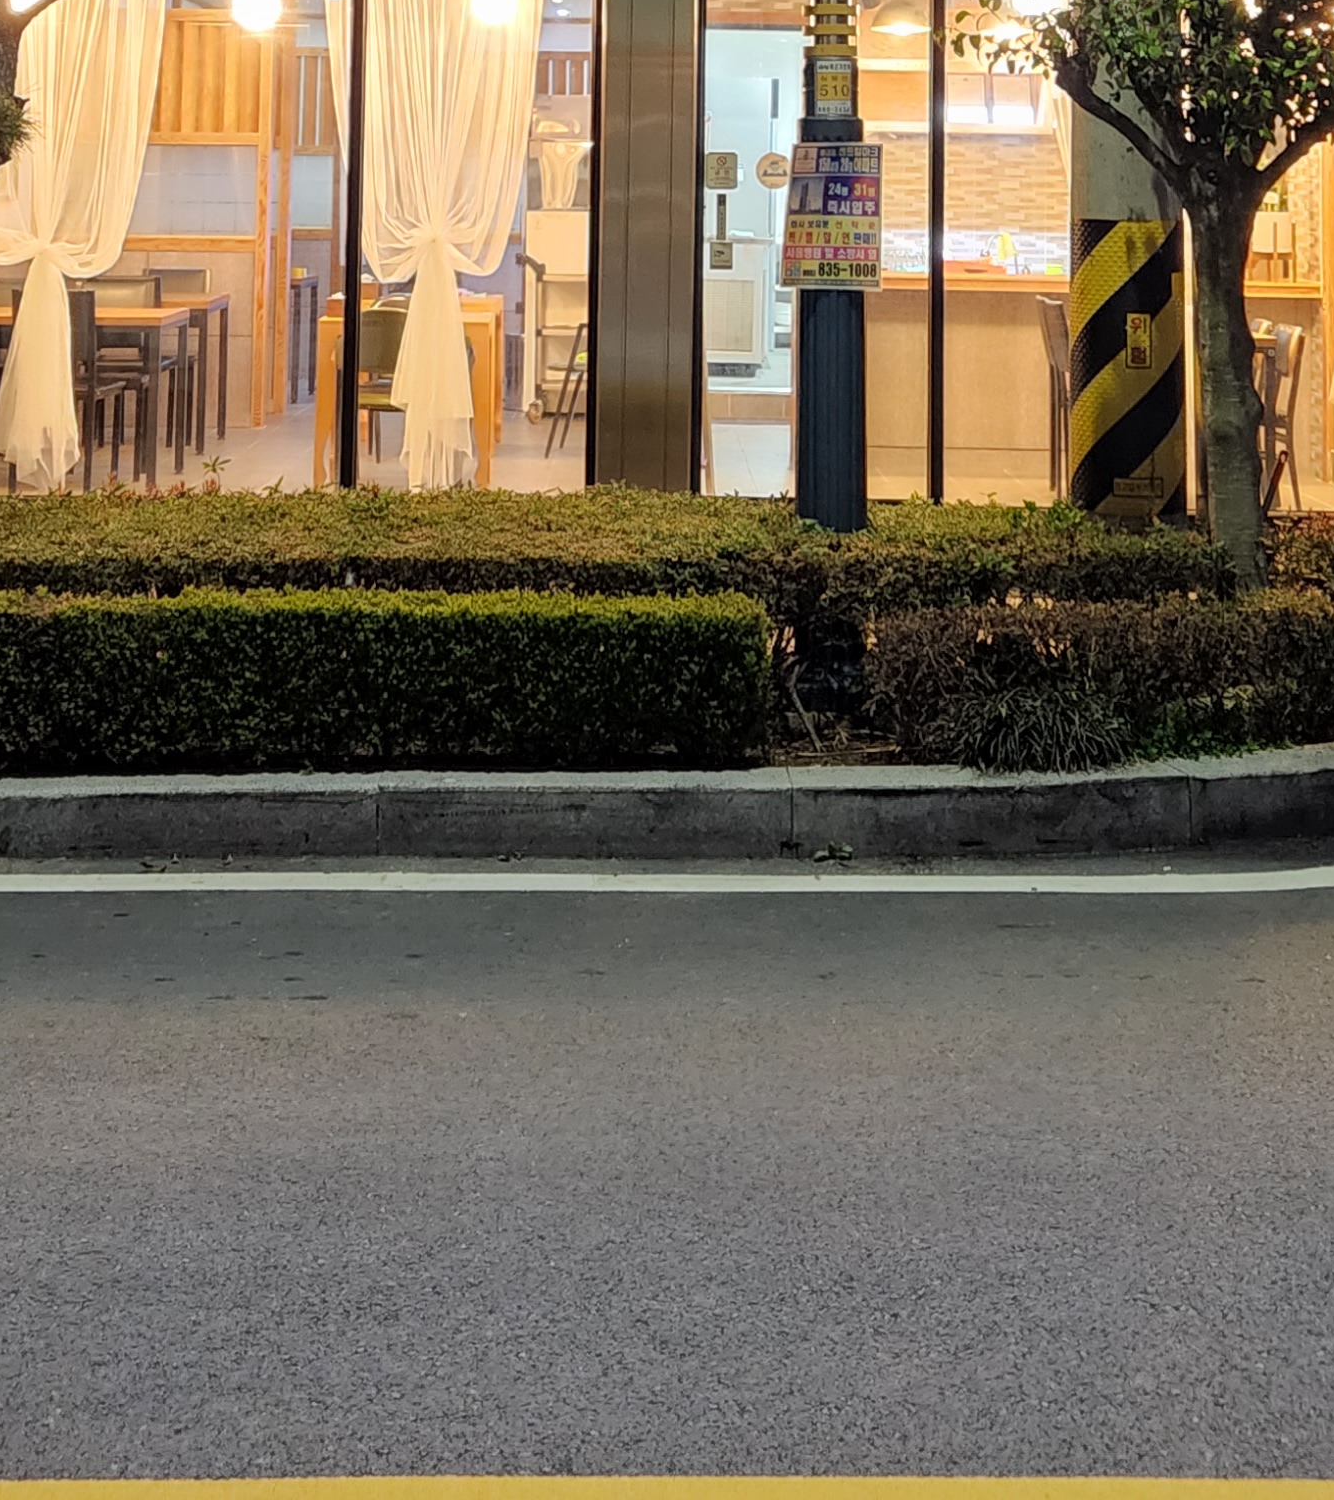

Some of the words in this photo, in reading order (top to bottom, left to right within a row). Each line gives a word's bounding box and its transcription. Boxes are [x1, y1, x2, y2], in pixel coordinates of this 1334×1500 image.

[819, 84, 850, 97] 510
[827, 200, 876, 215] 즉시입주
[818, 262, 877, 277] 835-1008
